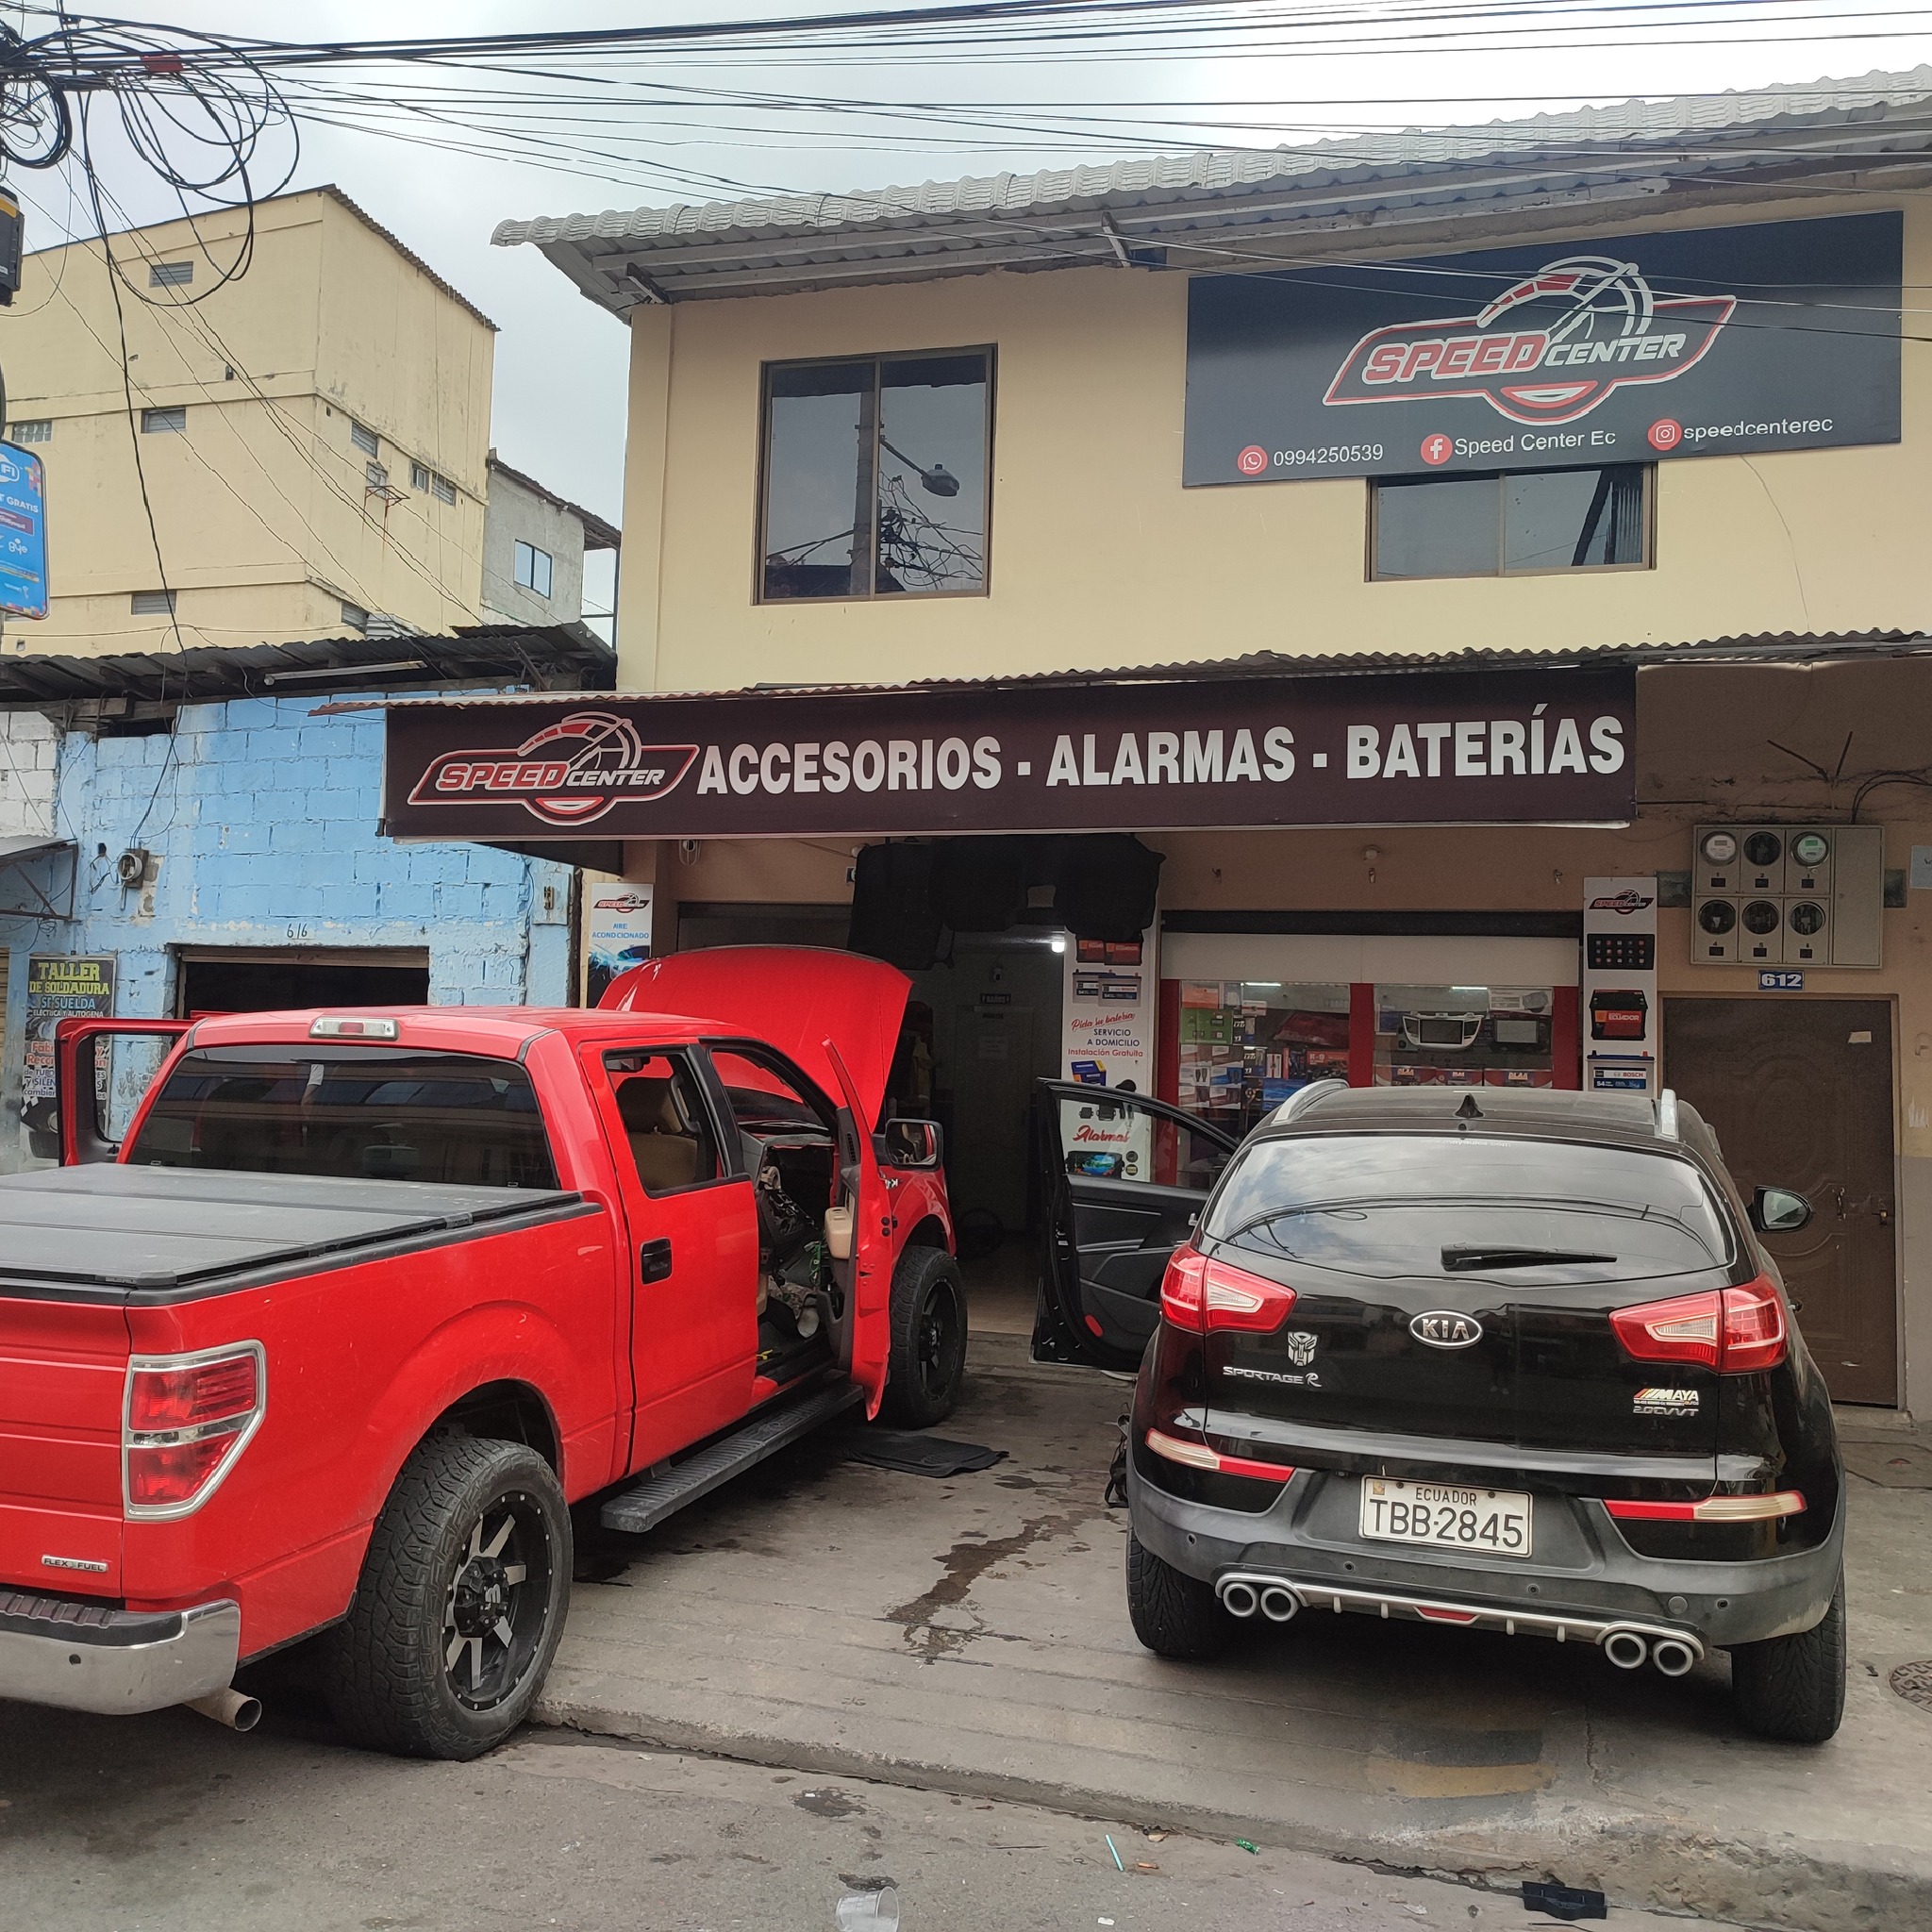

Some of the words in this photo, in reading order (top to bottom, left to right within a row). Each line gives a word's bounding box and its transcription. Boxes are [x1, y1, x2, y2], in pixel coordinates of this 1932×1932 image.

[1362, 331, 1550, 384] SPEED
[1544, 334, 1687, 367] CENTER
[1684, 417, 1833, 441] speedcenterec
[1455, 434, 1514, 458] Speed
[1521, 430, 1585, 452] Center
[1591, 431, 1616, 446] Ec
[1274, 444, 1384, 467] 0994250539
[7, 496, 39, 513] GRATIS
[696, 736, 1003, 795] ACCESORIOS
[1046, 727, 1295, 787] ALARMAS
[1346, 703, 1625, 780] BATERÍAS
[436, 761, 570, 792] SPEED
[567, 767, 665, 788] CENTER
[286, 923, 308, 939] 616
[591, 931, 649, 940] ACONDCIONADO
[39, 962, 100, 981] TALLER
[1761, 973, 1802, 987] 612
[29, 981, 42, 993] DE
[44, 981, 109, 994] SOLDADURA
[54, 996, 95, 1009] SUELDA
[1071, 1019, 1093, 1031] Pida
[1093, 1028, 1131, 1037] SERVICIO
[1095, 1039, 1141, 1047] DOMICILIO
[1068, 1048, 1110, 1057] Instalación
[1111, 1049, 1143, 1058] Gratuita
[1073, 1124, 1130, 1142] Alarmas
[1422, 1318, 1471, 1341] KIA
[1223, 1366, 1304, 1385] SPORTAGE
[1305, 1372, 1323, 1388] R
[1415, 1487, 1477, 1507] ECUADOR
[43, 1557, 68, 1568] FLEX
[77, 1562, 104, 1572] FUEL
